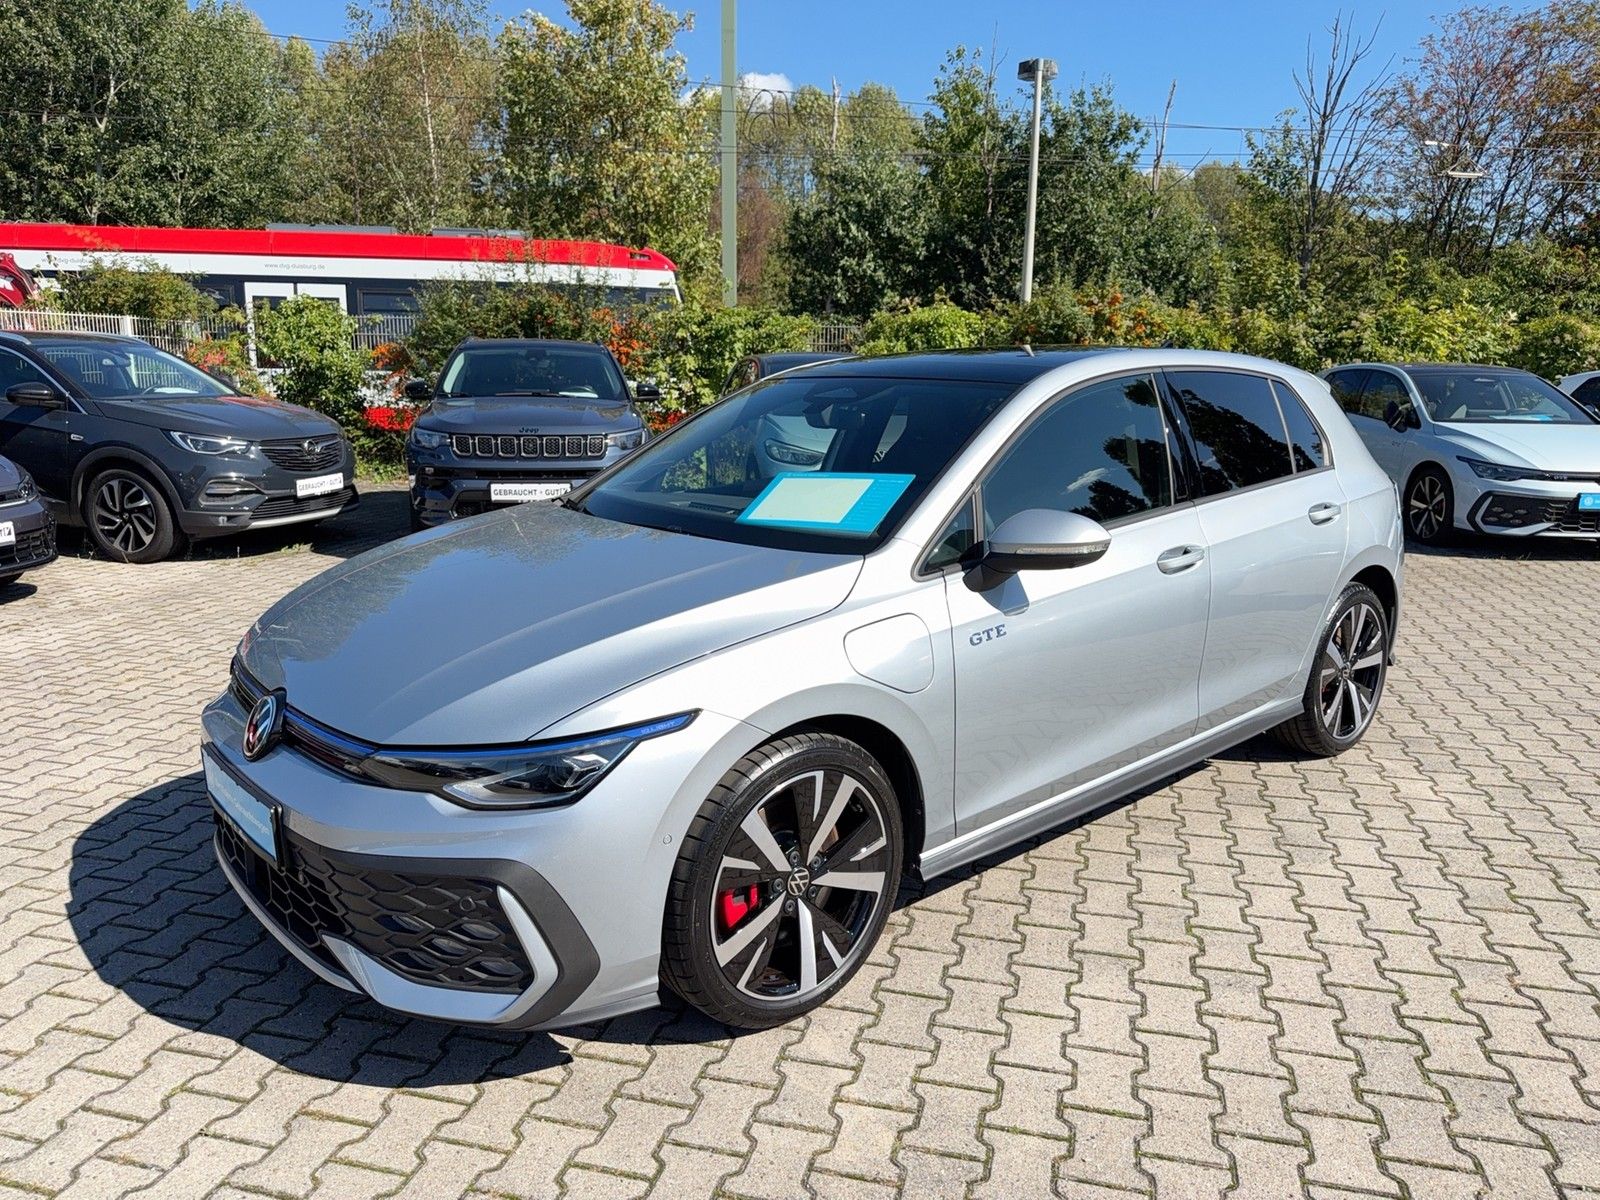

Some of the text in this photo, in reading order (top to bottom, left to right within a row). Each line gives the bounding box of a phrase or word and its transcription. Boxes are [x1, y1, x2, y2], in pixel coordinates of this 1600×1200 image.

[493, 488, 559, 496] GEBRAUCHT GUT
[969, 623, 1007, 646] GTE
